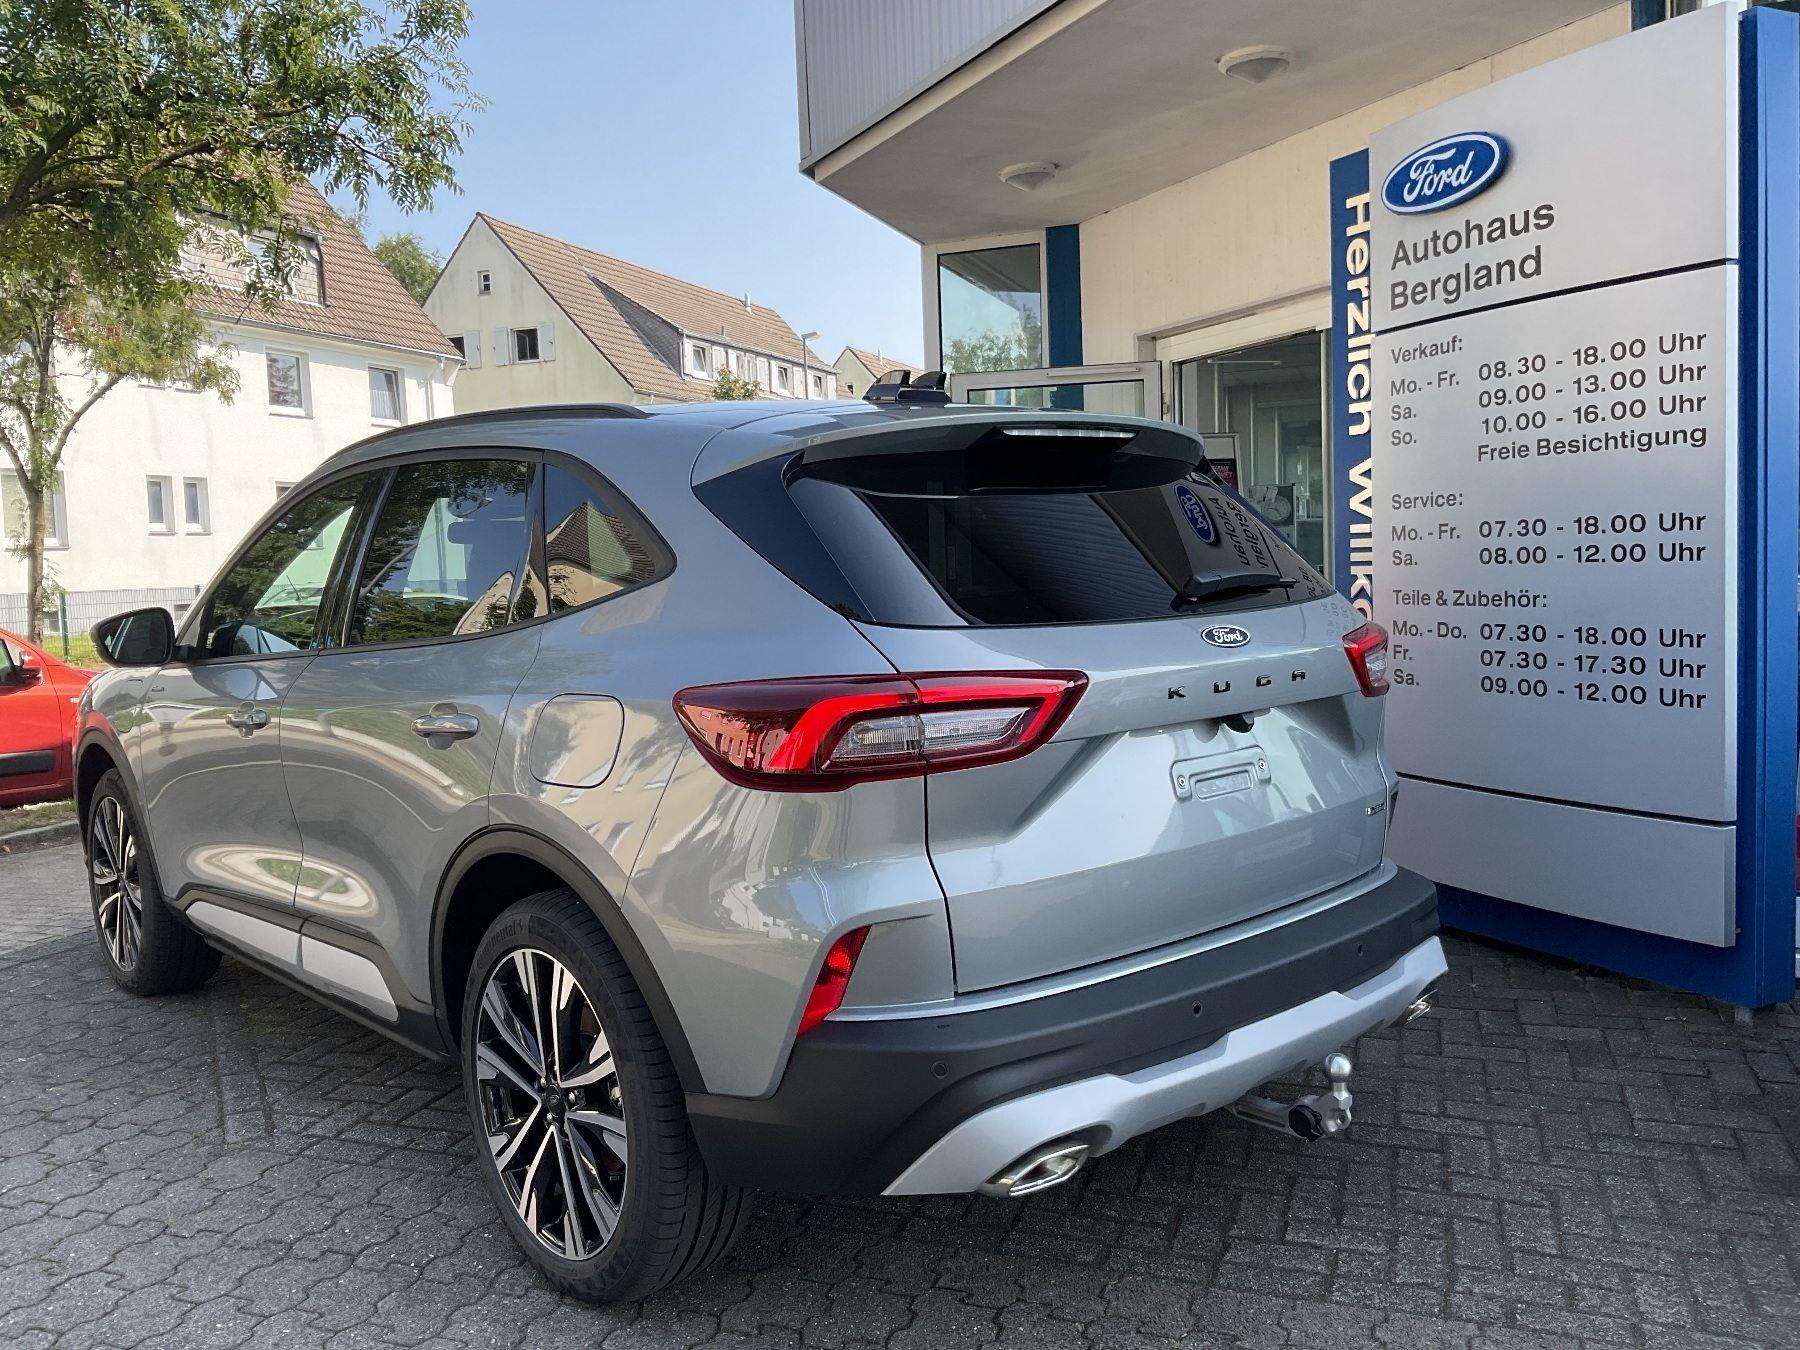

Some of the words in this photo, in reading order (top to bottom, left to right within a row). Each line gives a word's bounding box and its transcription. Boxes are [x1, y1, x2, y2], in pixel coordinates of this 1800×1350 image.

[1403, 148, 1473, 203] Ford
[1391, 203, 1555, 272] Autohaus
[1390, 244, 1543, 312] Bergland
[1345, 192, 1374, 436] Herzlich
[1391, 338, 1463, 365] Verkauf:
[1478, 354, 1546, 382] 08.30
[1572, 342, 1647, 367] 18.00
[1658, 331, 1707, 356] Uhr
[1391, 405, 1417, 422] Sa.
[1478, 383, 1547, 409] 09.00
[1572, 369, 1647, 396] 13.00
[1658, 363, 1707, 385] Uhr
[1391, 430, 1417, 447] So.
[1482, 411, 1547, 435] 10.00
[1572, 399, 1647, 425] 16.00
[1658, 394, 1707, 416] Uhr
[1477, 442, 1530, 463] Freie
[1536, 427, 1707, 458] Besichtigung
[1391, 490, 1464, 511] Service:
[1478, 519, 1547, 539] 07.30
[1572, 514, 1647, 535] 18.00
[1658, 512, 1707, 533] Uhr
[1392, 550, 1418, 567] Sa.
[1479, 546, 1547, 566] 08.00
[1572, 544, 1647, 564] 12.00
[1658, 543, 1707, 563] Uhr
[1392, 589, 1432, 606] Teile
[1435, 589, 1449, 607] &
[1452, 589, 1548, 608] Zubehör:
[1212, 628, 1244, 643] Ford
[1479, 623, 1547, 643] 07.30
[1573, 626, 1647, 647] 18.00
[1658, 628, 1707, 649] Uhr
[1393, 645, 1413, 661] Fr.
[1480, 650, 1548, 671] 07.30
[1573, 655, 1647, 676] 17.30
[1659, 658, 1707, 679] Uhr
[1167, 669, 1306, 700] KUGA
[1393, 668, 1420, 687] Sa.
[1480, 676, 1548, 698] 09.00
[1573, 683, 1647, 705] 12.00
[1659, 688, 1707, 709] Uhr
